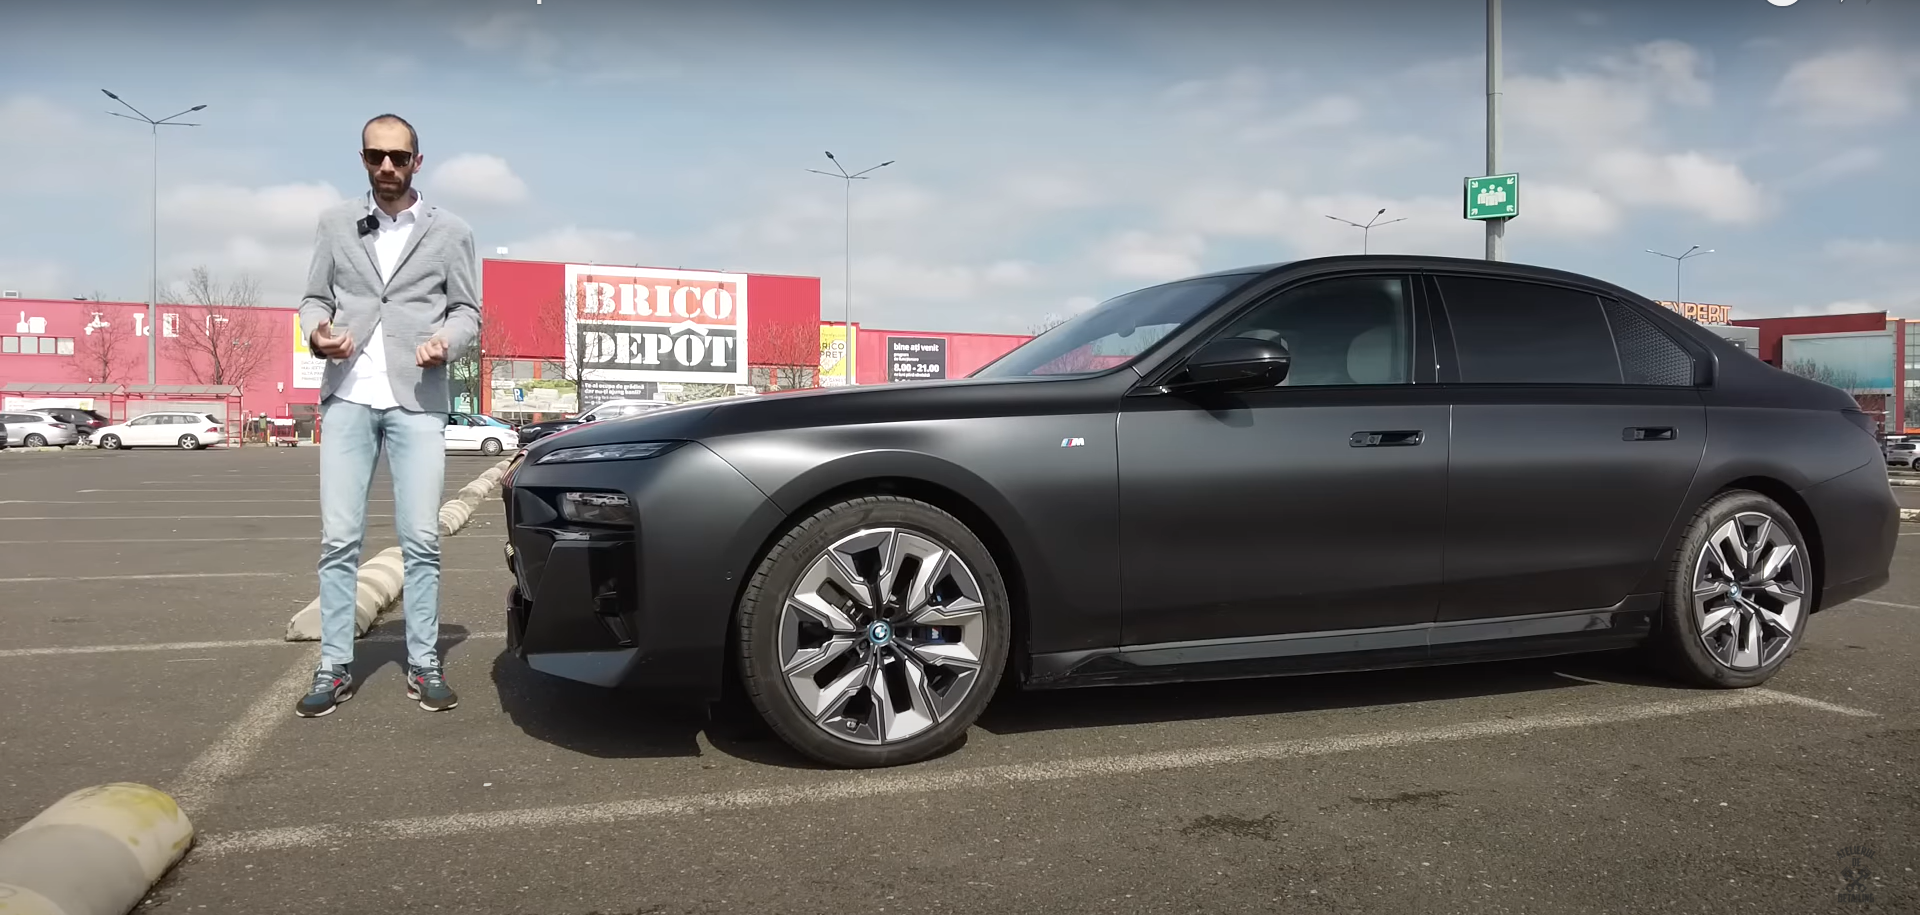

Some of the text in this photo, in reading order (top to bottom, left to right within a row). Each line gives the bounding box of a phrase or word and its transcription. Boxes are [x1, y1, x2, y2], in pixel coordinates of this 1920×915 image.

[582, 282, 733, 320] BRICO
[894, 343, 909, 351] bine
[921, 344, 939, 352] venit
[894, 364, 911, 372] 8.00
[916, 364, 940, 373] 21.00
